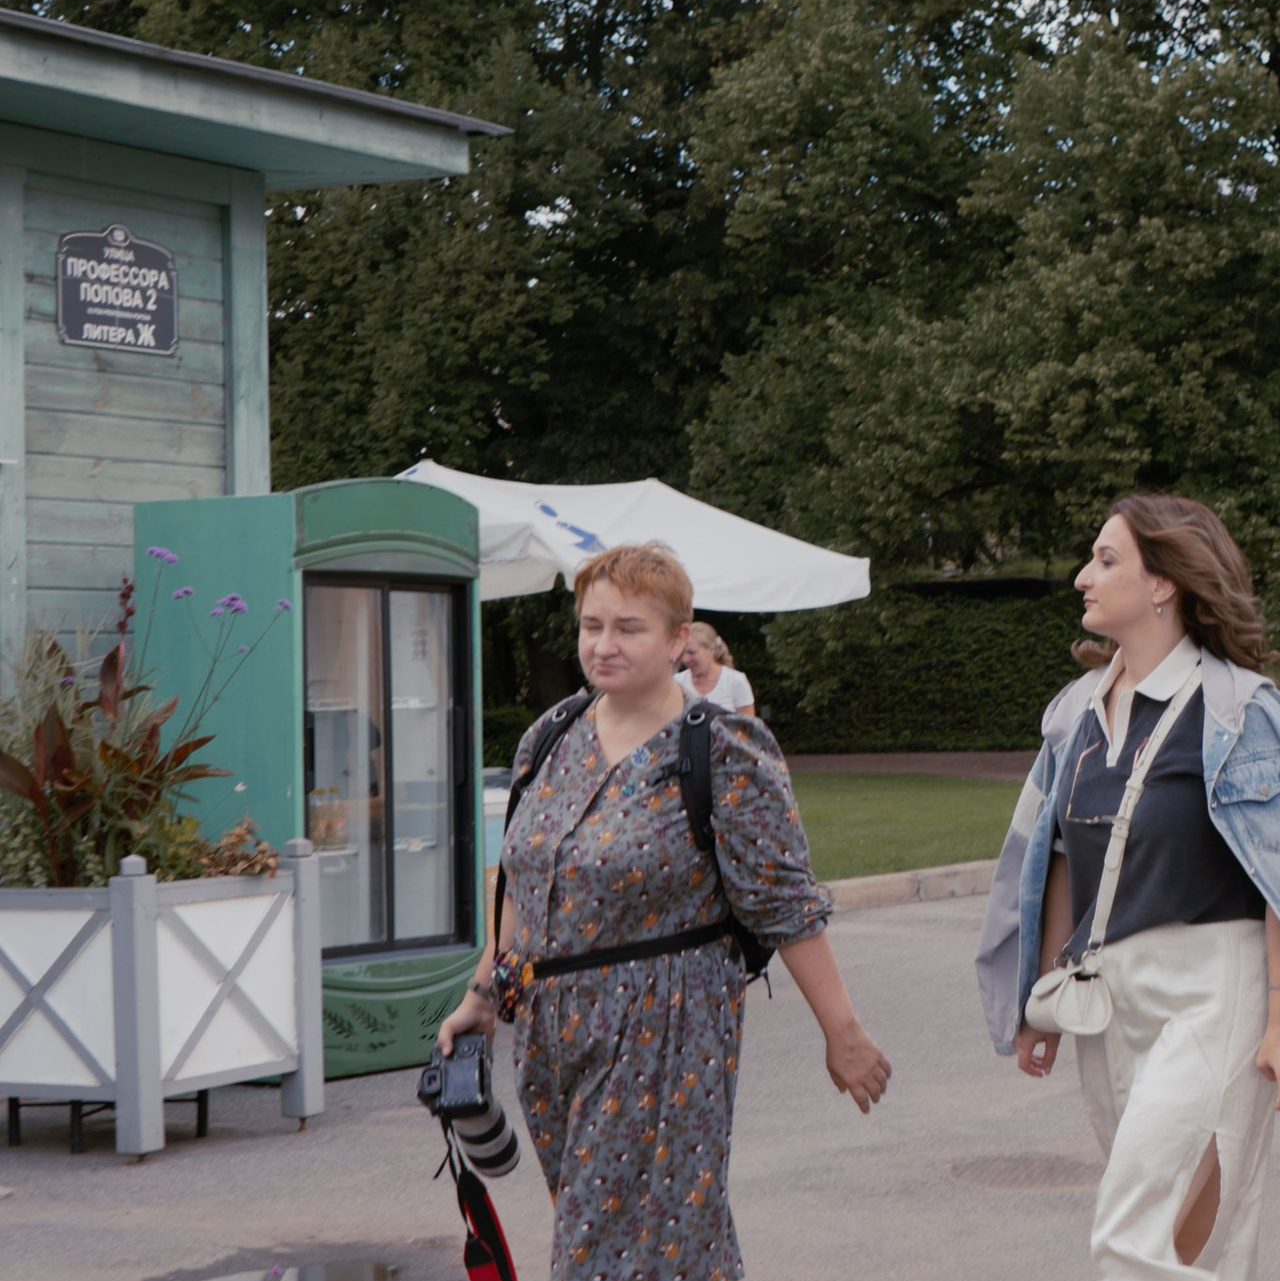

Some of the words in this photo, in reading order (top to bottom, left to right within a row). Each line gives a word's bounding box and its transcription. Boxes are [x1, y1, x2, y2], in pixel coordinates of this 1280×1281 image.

[103, 247, 135, 262] УЛИЦА
[67, 257, 169, 290] ПРОФЕССОРА
[80, 283, 143, 308] ПОПОВА
[146, 289, 157, 310] 2
[82, 323, 136, 344] ЛИТЕРА
[137, 323, 156, 346] Ж
